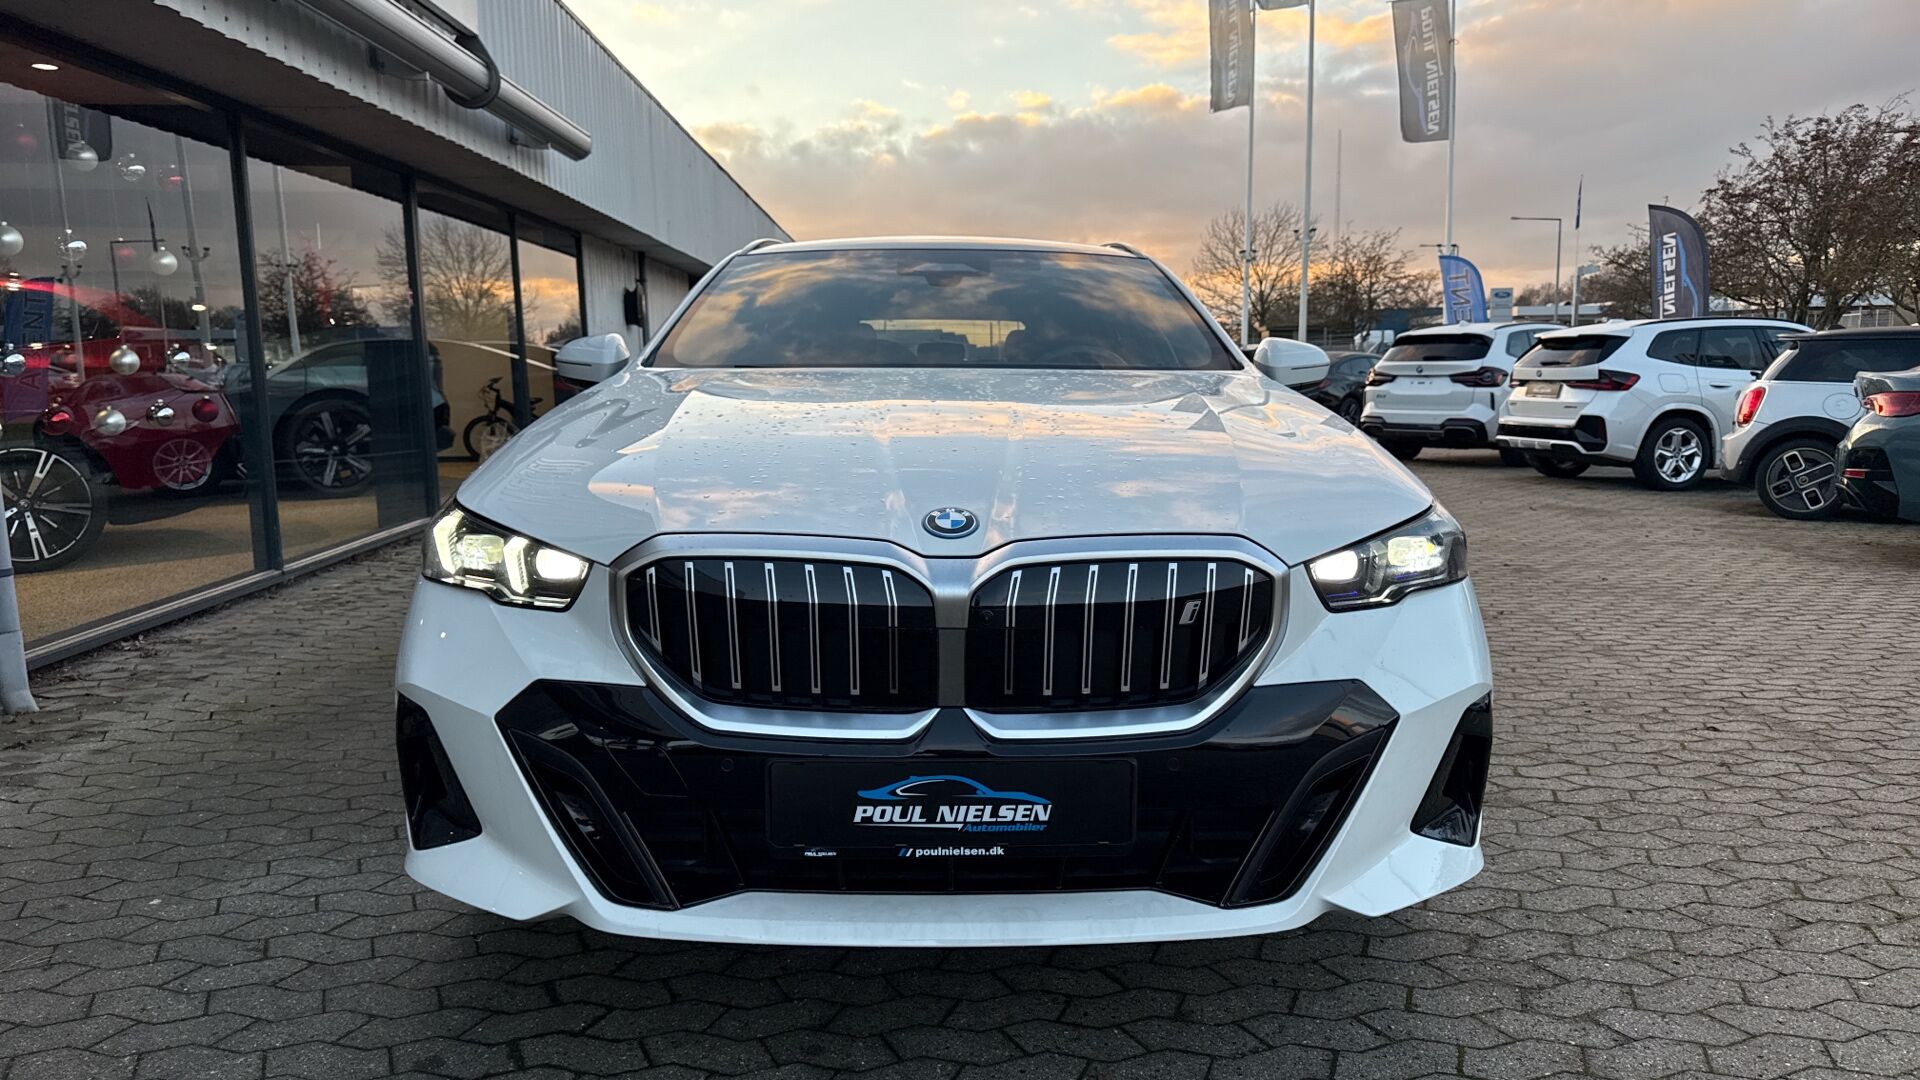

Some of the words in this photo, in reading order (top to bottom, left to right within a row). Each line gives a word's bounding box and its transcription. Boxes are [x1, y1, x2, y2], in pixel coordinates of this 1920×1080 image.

[853, 805, 928, 823] POUL
[936, 804, 1052, 823] NIELSEN
[963, 823, 1048, 832] Automobiler
[915, 846, 1005, 857] poulnielsen.dk
